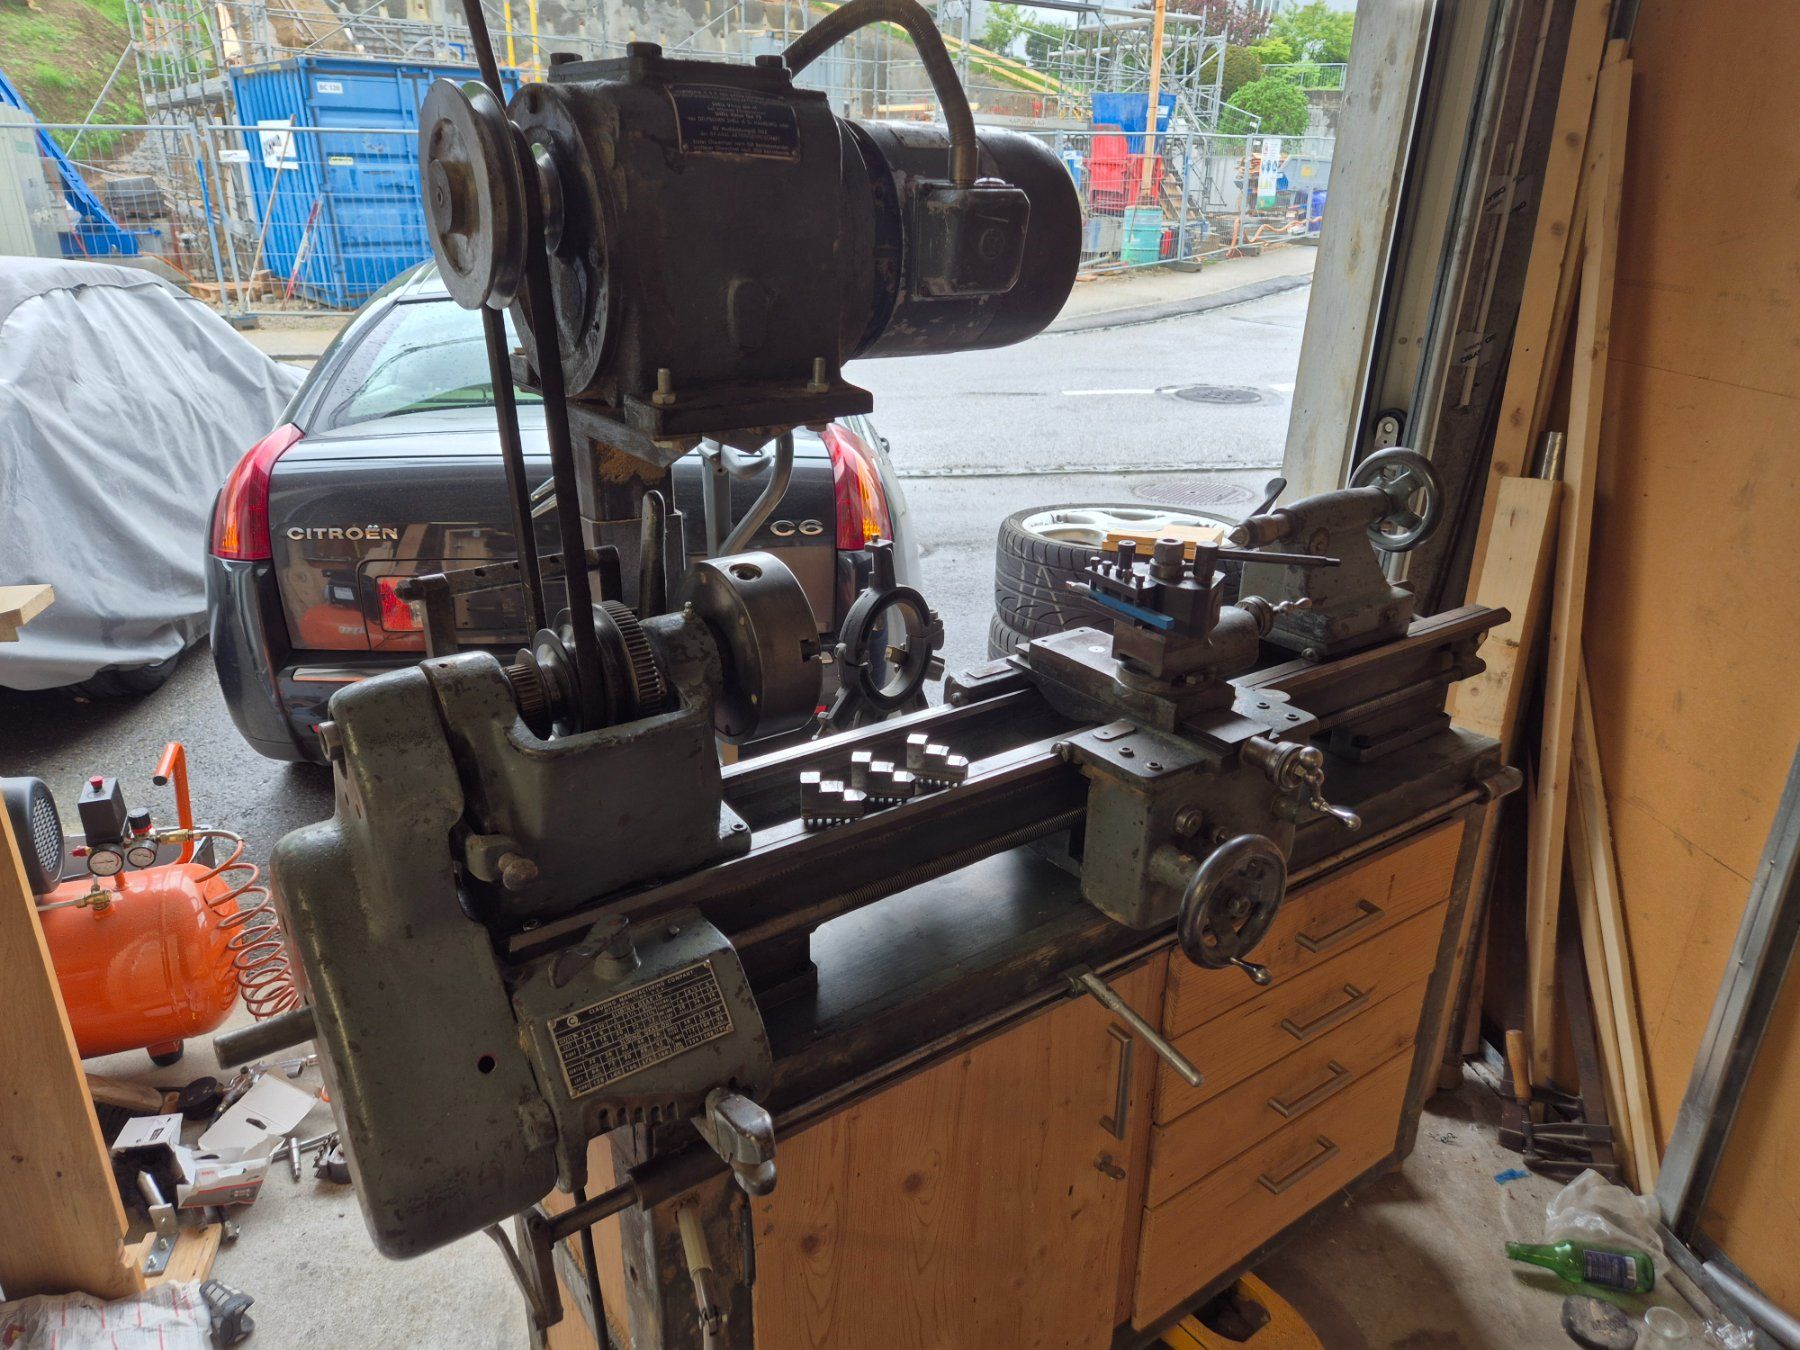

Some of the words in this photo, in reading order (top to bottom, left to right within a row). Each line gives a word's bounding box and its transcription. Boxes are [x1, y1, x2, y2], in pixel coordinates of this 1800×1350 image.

[286, 524, 399, 541] CITROËN
[770, 519, 824, 537] C6
[588, 1000, 616, 1014] CLAUSING
[619, 981, 664, 1002] MANUFACTURING
[667, 969, 693, 983] COMPANY
[611, 1004, 635, 1017] SLIDING
[637, 997, 652, 1006] GEAR
